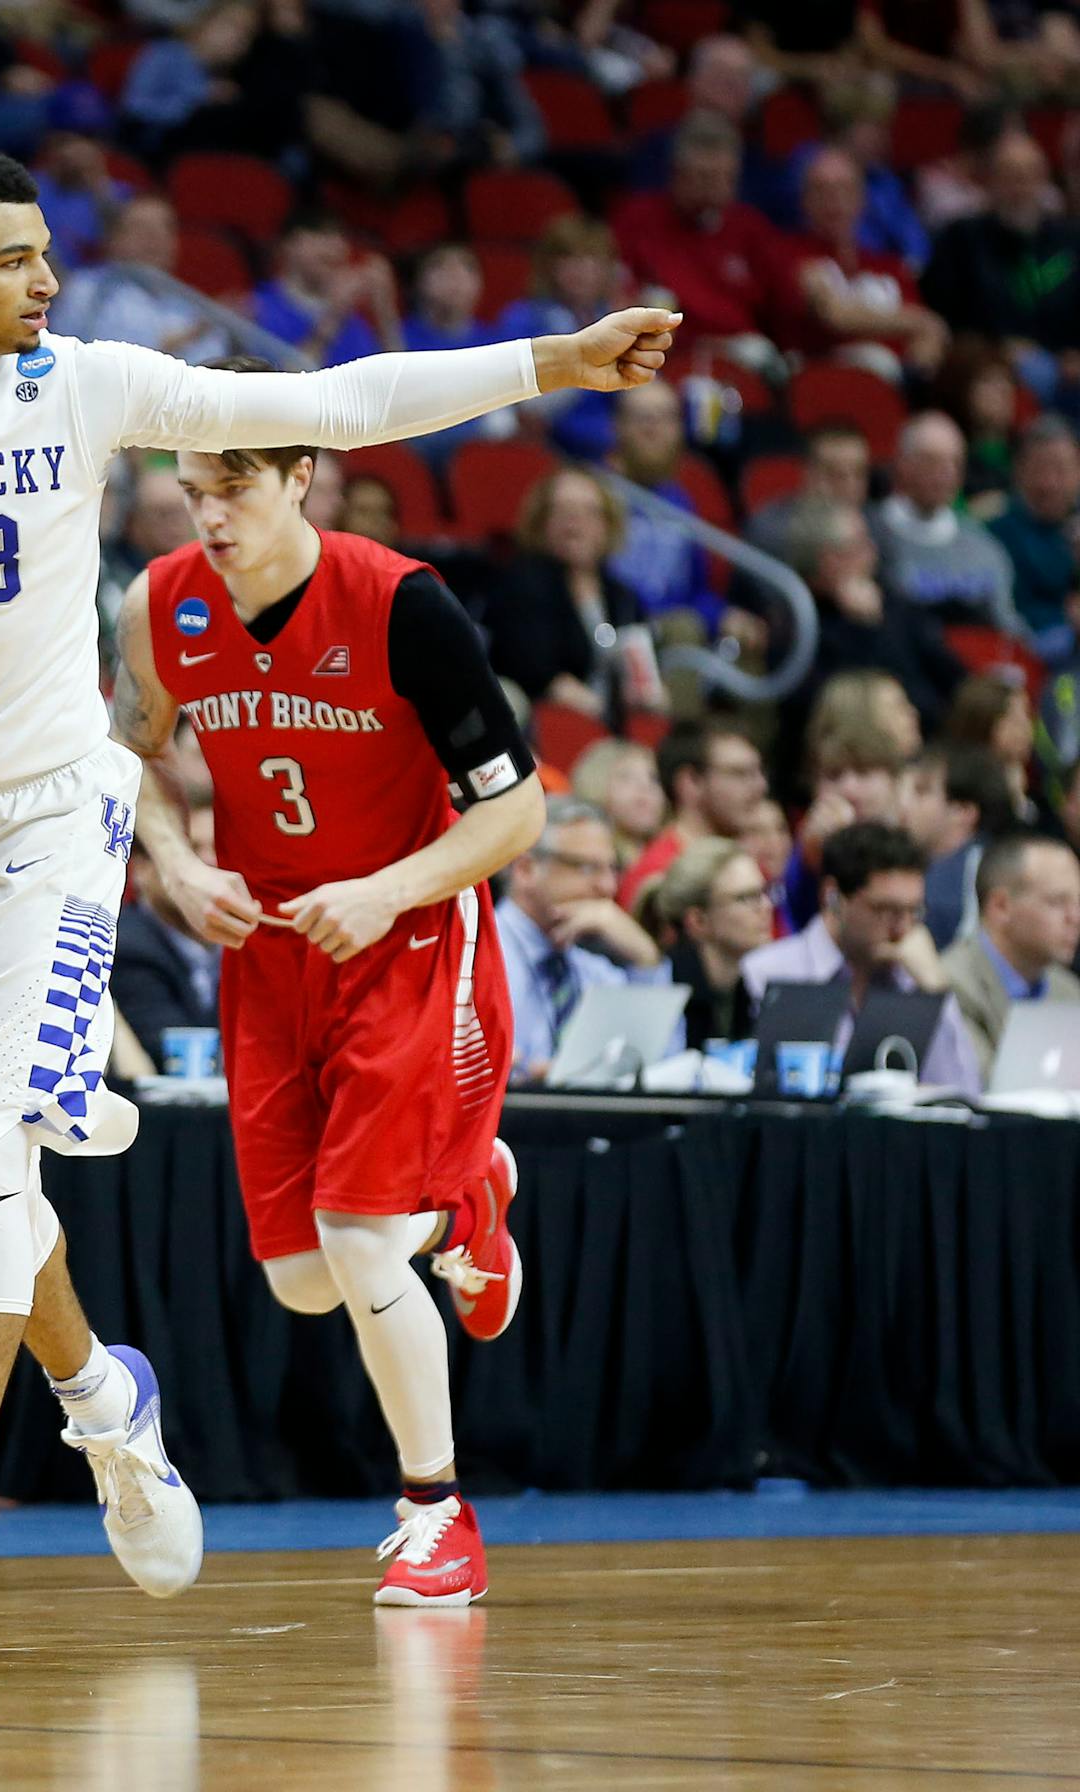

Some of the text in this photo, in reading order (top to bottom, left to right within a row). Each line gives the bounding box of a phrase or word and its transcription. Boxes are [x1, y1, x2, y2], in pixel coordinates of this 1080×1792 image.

[17, 382, 38, 401] SEC
[270, 691, 384, 732] BROOK
[259, 756, 316, 836] 3
[102, 795, 133, 861] UK
